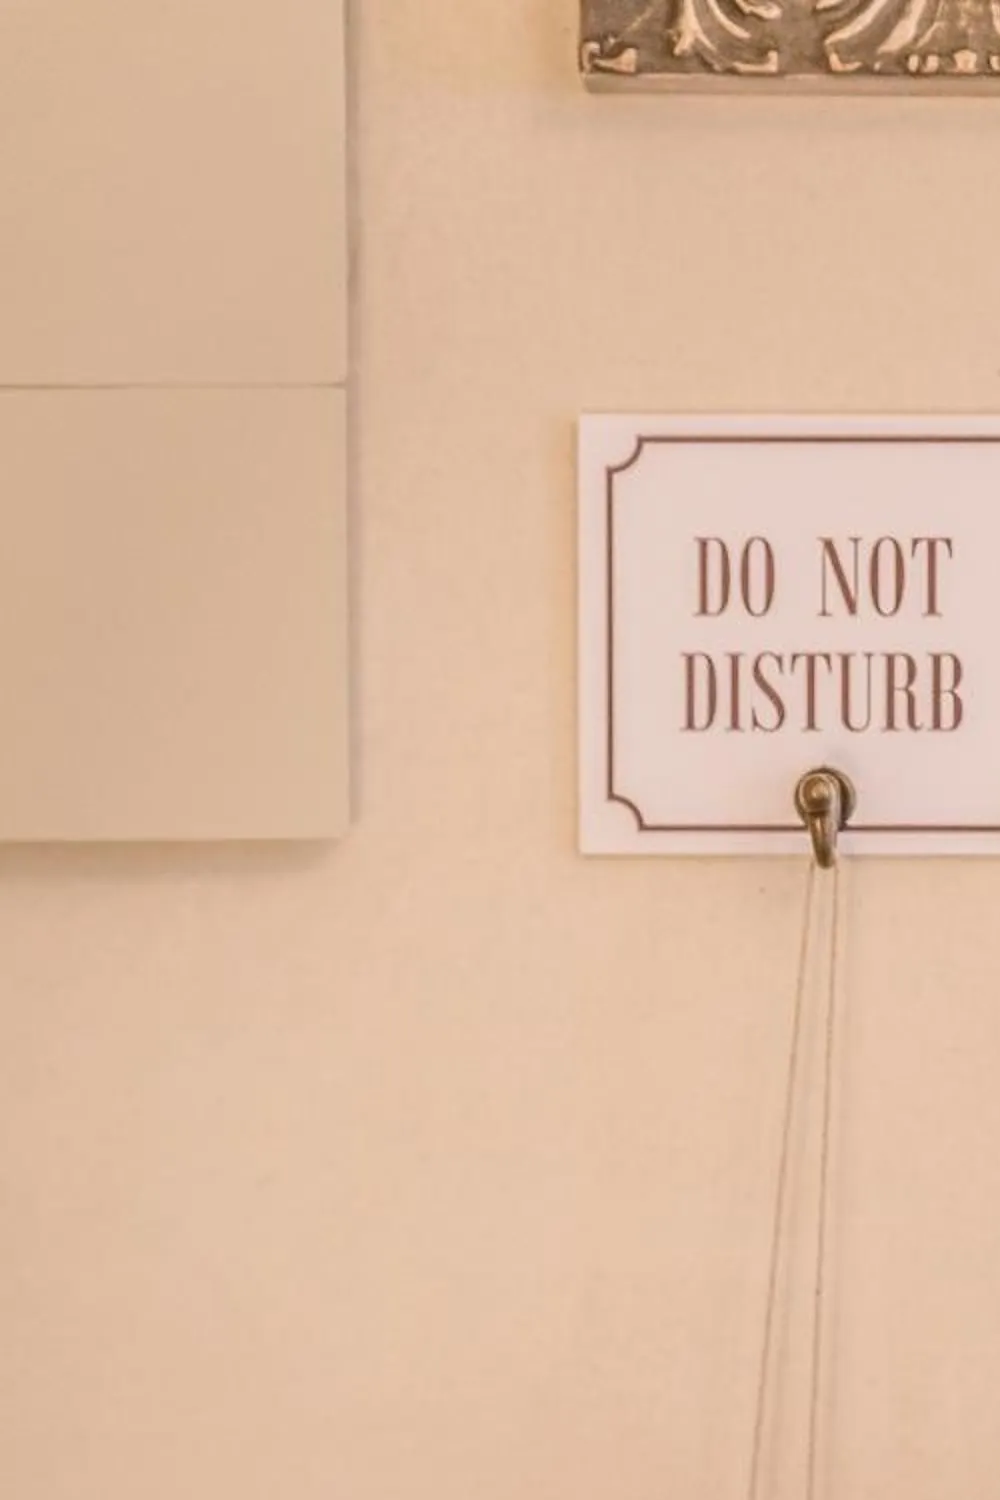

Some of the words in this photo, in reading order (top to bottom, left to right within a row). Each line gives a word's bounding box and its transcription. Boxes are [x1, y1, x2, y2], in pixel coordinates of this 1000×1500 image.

[695, 536, 775, 617] DO
[818, 536, 953, 617] NOT
[681, 652, 963, 733] DISTURB
